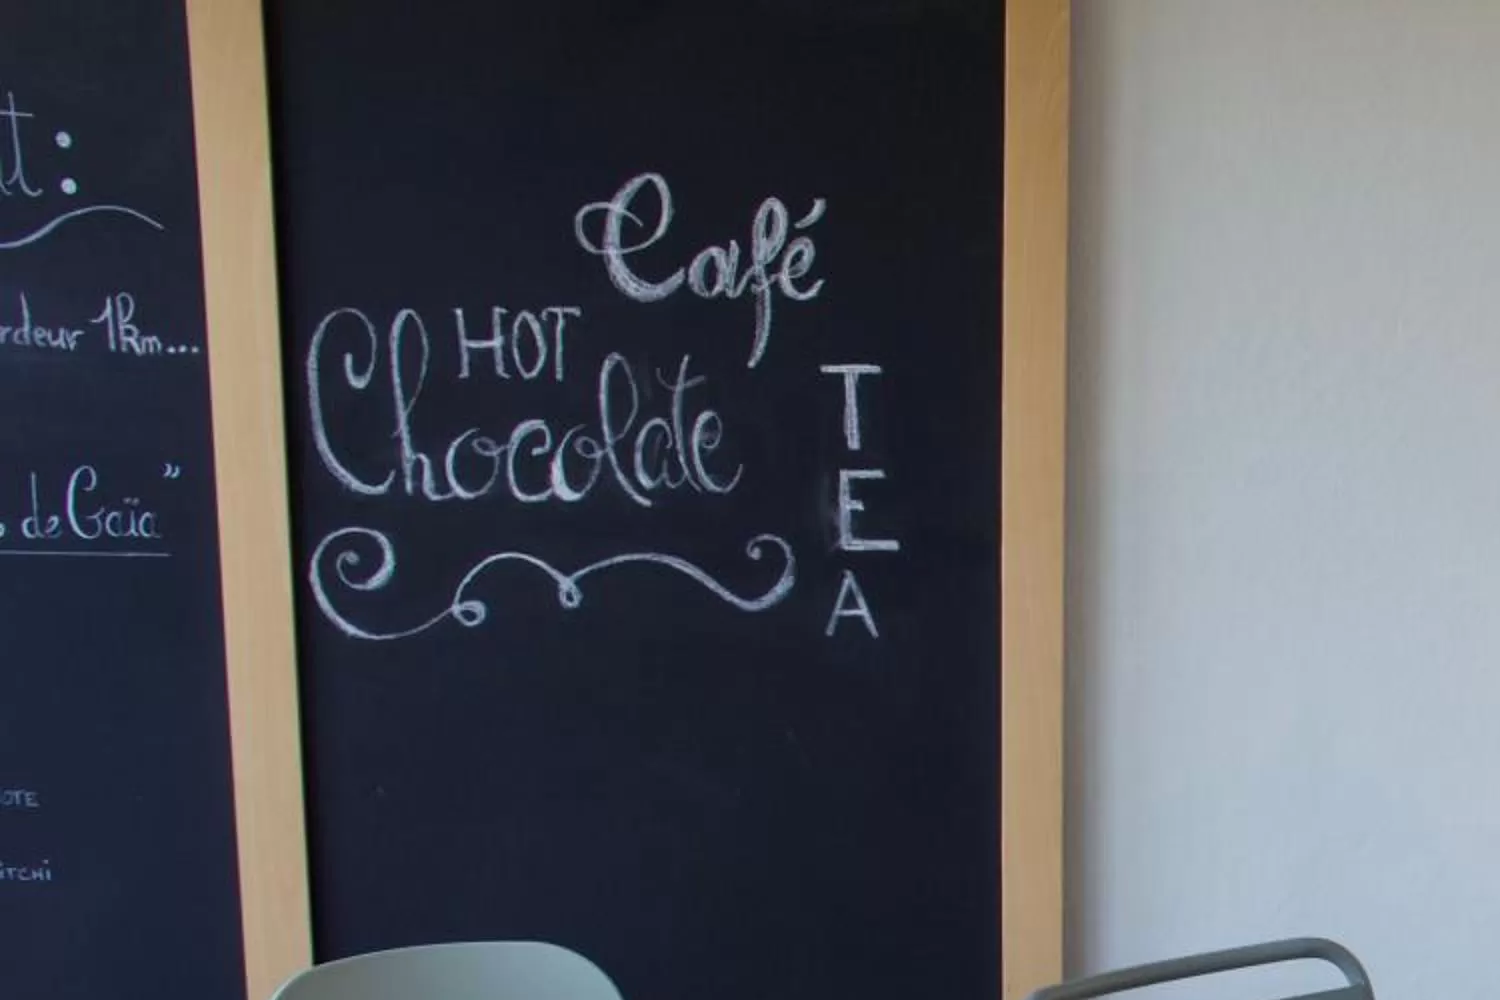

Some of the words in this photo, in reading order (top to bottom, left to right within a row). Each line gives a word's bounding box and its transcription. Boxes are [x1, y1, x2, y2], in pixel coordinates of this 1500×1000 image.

[456, 307, 582, 381] HOT
[575, 172, 827, 368] Café
[307, 307, 744, 506] Chocolate
[820, 363, 900, 639] TEA
